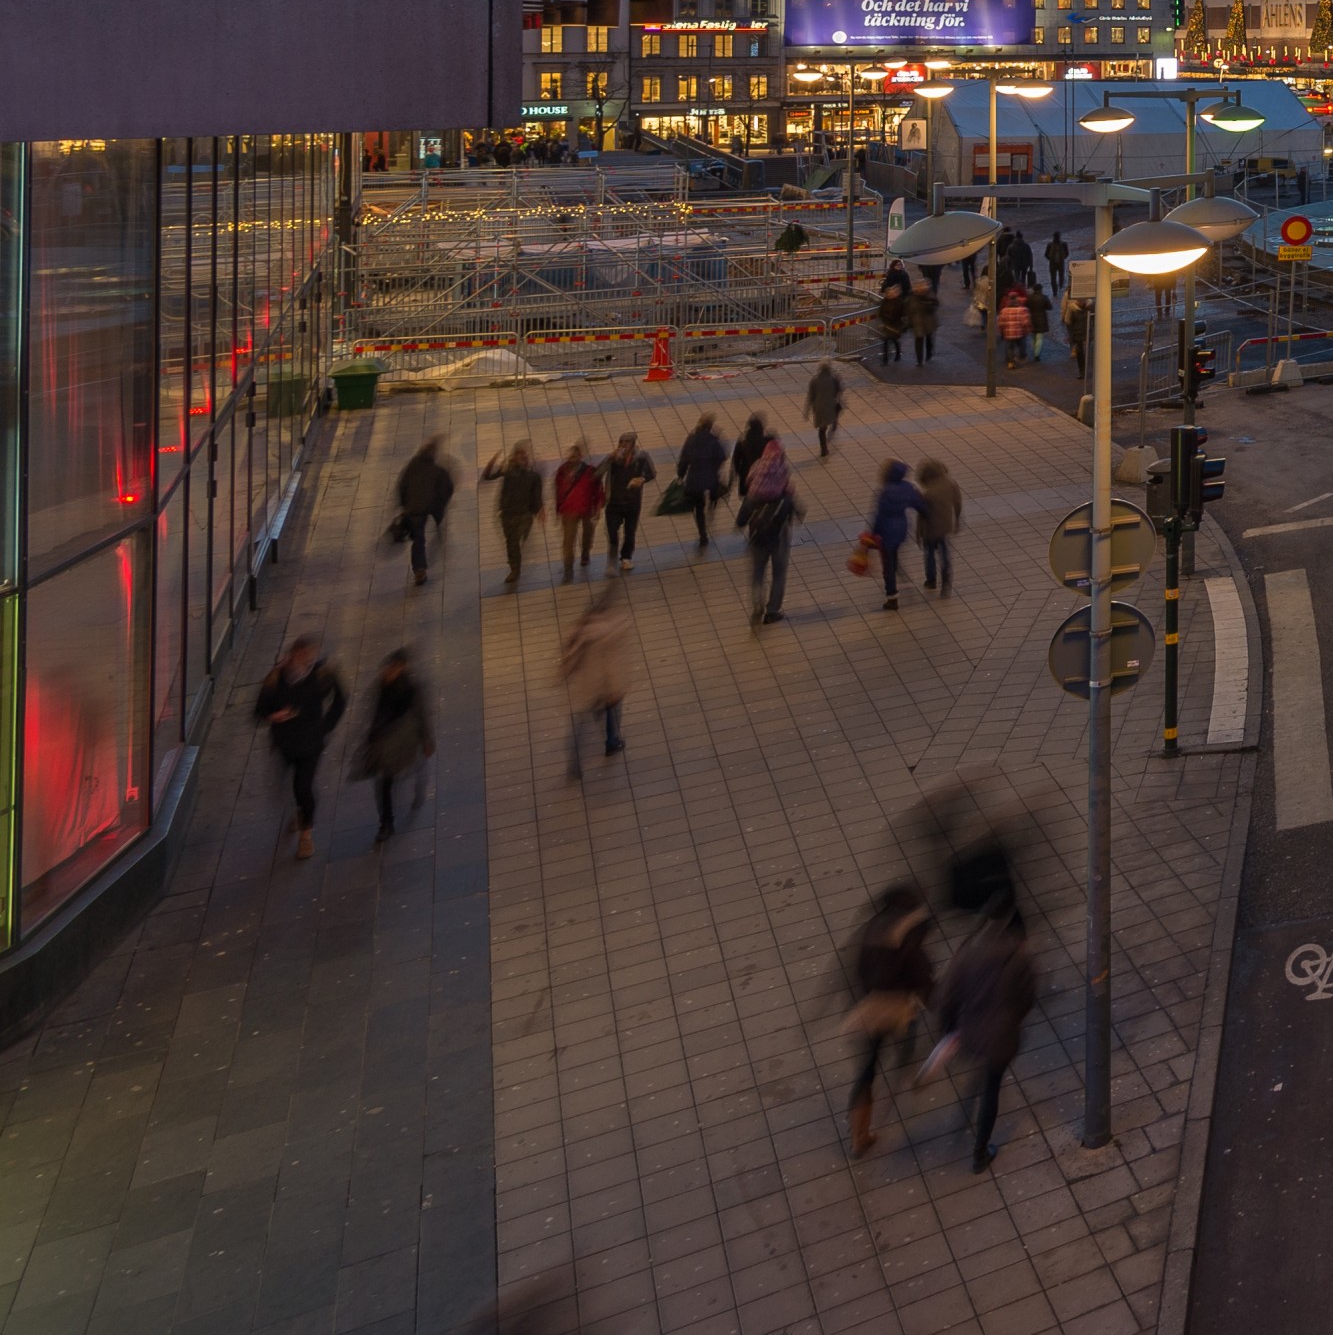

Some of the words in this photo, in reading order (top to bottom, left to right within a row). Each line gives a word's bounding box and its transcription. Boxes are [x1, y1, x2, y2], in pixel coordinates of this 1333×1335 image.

[954, 0, 969, 12] vi
[699, 19, 768, 31] Fastigter
[864, 13, 936, 30] täckning
[937, 13, 966, 29] för.
[529, 106, 568, 115] HOUSE
